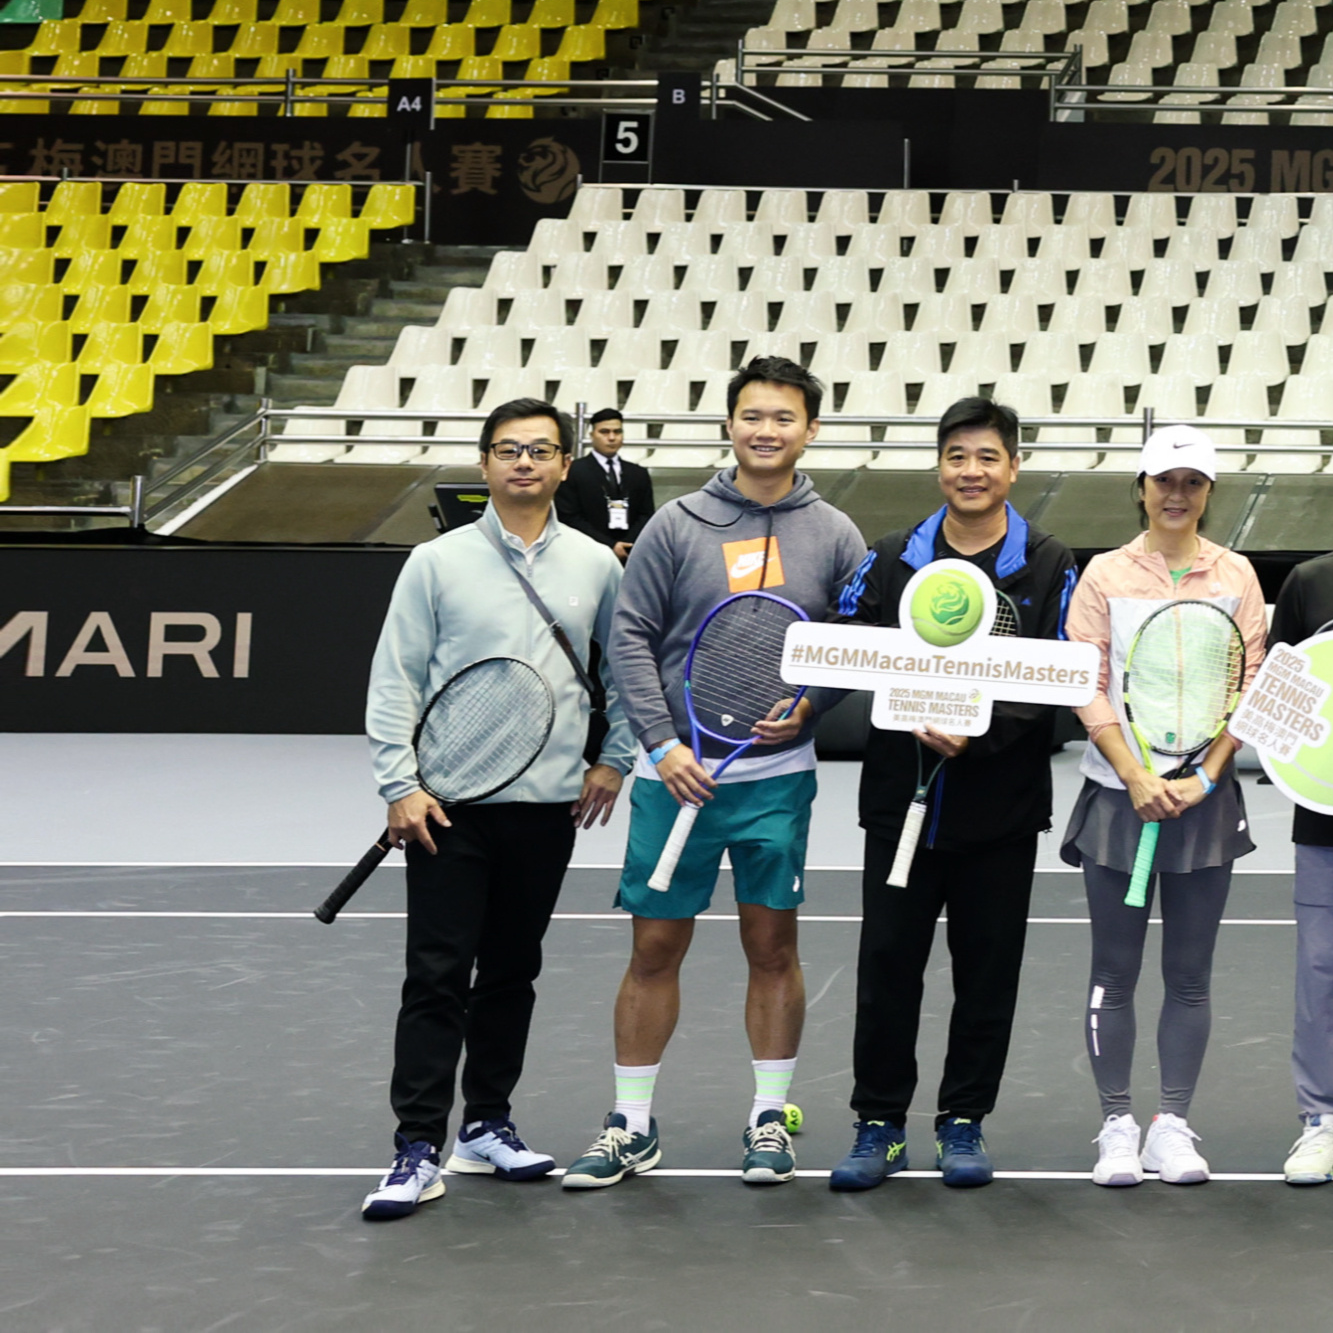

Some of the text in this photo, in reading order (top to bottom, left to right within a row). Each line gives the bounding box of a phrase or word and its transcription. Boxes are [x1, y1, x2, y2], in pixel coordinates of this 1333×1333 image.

[397, 96, 422, 113] A4
[670, 89, 686, 104] B
[614, 121, 639, 154] 5
[1148, 146, 1255, 194] 2025
[790, 644, 1089, 686] #MGMMacauTennisMasters
[1275, 648, 1306, 672] 2025
[889, 687, 967, 703] 2025 MGM MACAU
[1258, 672, 1317, 715] TENNIS
[1267, 663, 1325, 699] MGM MACAU
[888, 698, 980, 719] TENNIS MASTERS
[1247, 692, 1325, 741] MASTERS
